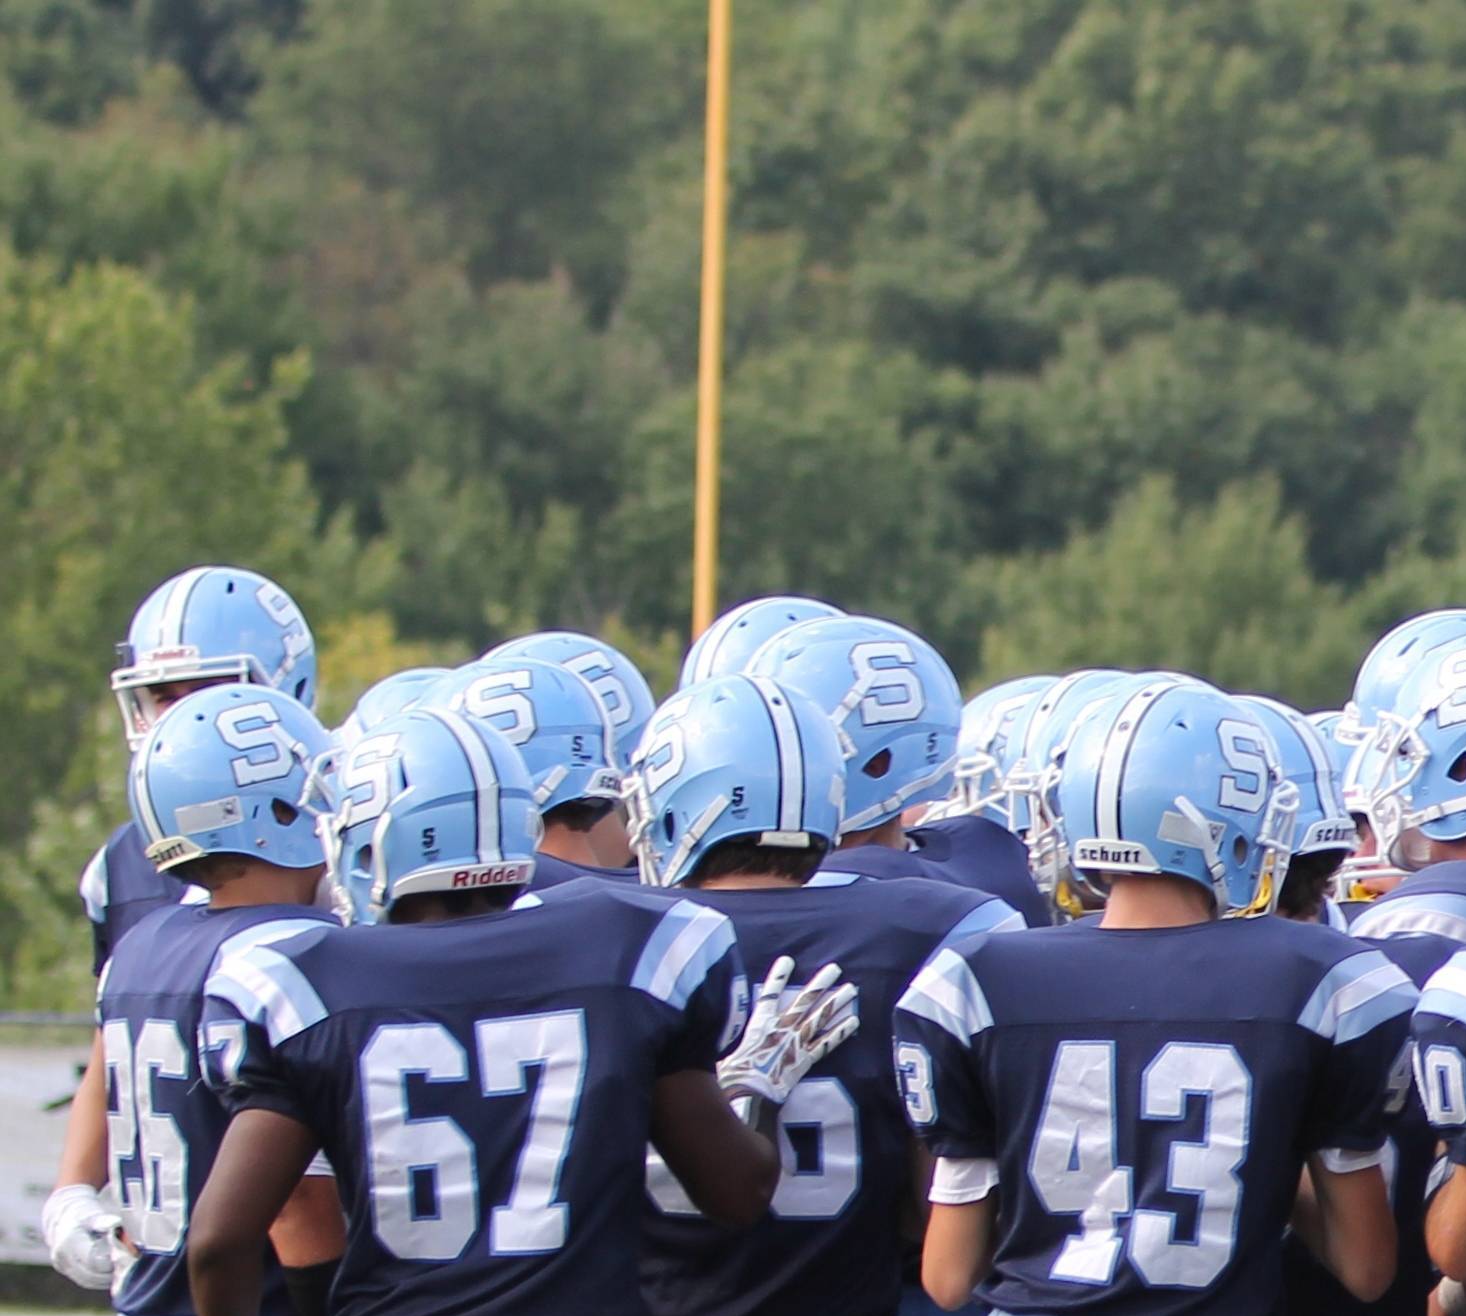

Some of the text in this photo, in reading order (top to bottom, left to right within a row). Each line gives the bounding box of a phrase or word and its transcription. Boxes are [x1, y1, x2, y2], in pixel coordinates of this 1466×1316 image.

[465, 669, 537, 747] S
[849, 640, 926, 727] S
[215, 701, 296, 788] S
[1215, 718, 1271, 814] S
[1079, 846, 1142, 866] schutt
[197, 1018, 248, 1091] 7
[892, 1034, 939, 1128] 3
[360, 1008, 588, 1263] 67
[1028, 1040, 1252, 1289] 43
